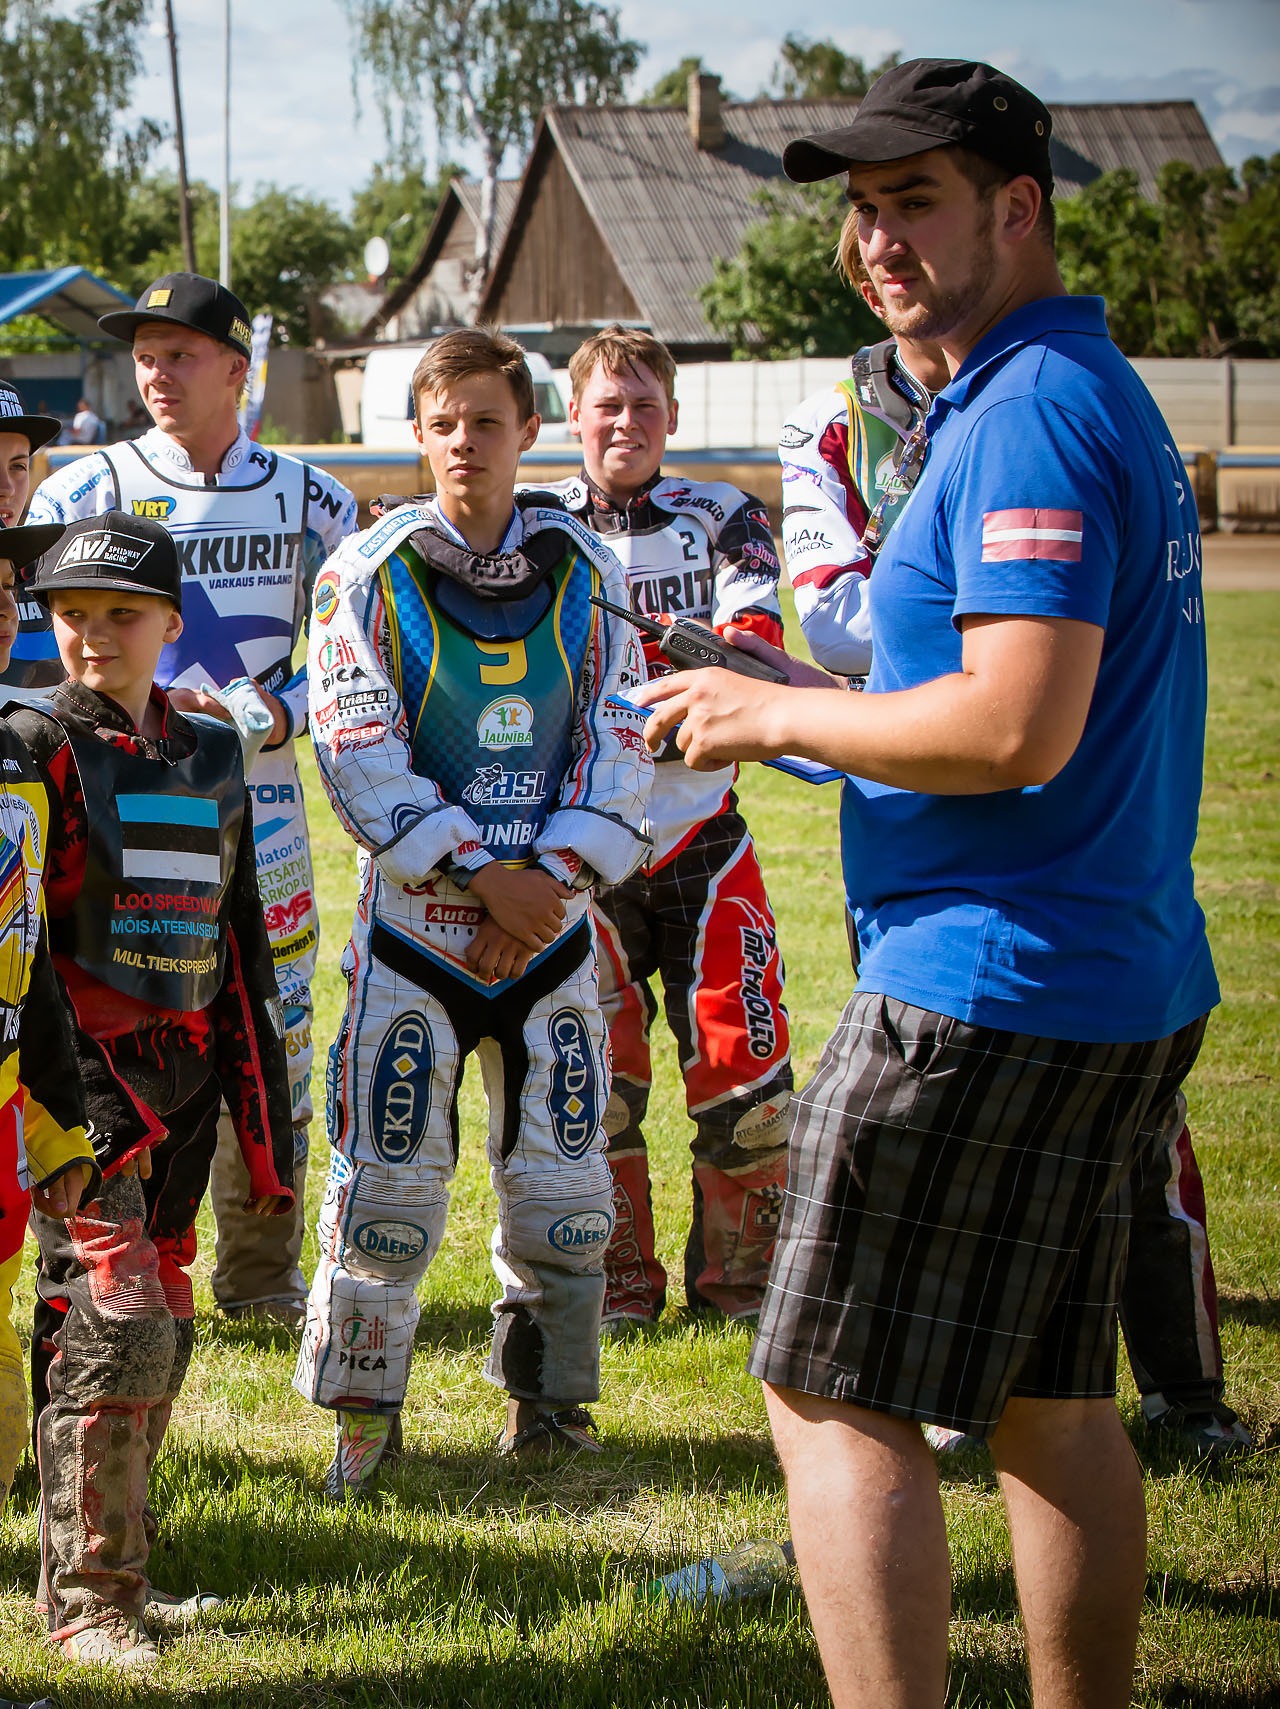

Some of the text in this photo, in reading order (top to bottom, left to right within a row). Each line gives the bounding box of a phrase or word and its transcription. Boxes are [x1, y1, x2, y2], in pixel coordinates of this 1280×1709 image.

[132, 500, 170, 517] VRT
[275, 492, 288, 523] 1
[539, 511, 595, 547] EAST METAL
[680, 531, 698, 561] 2
[209, 574, 293, 589] VARKAUS FINLAND
[481, 728, 533, 745] JAUNĪBA
[115, 893, 153, 910] LOO
[428, 906, 479, 923] Auto
[113, 948, 209, 974] MULTIEKSPRESS
[555, 1016, 588, 1093] CKD
[382, 1081, 416, 1157] CKD
[366, 1231, 420, 1256] DAERS
[562, 1227, 607, 1248] DAERS
[338, 1350, 388, 1372] PICA
